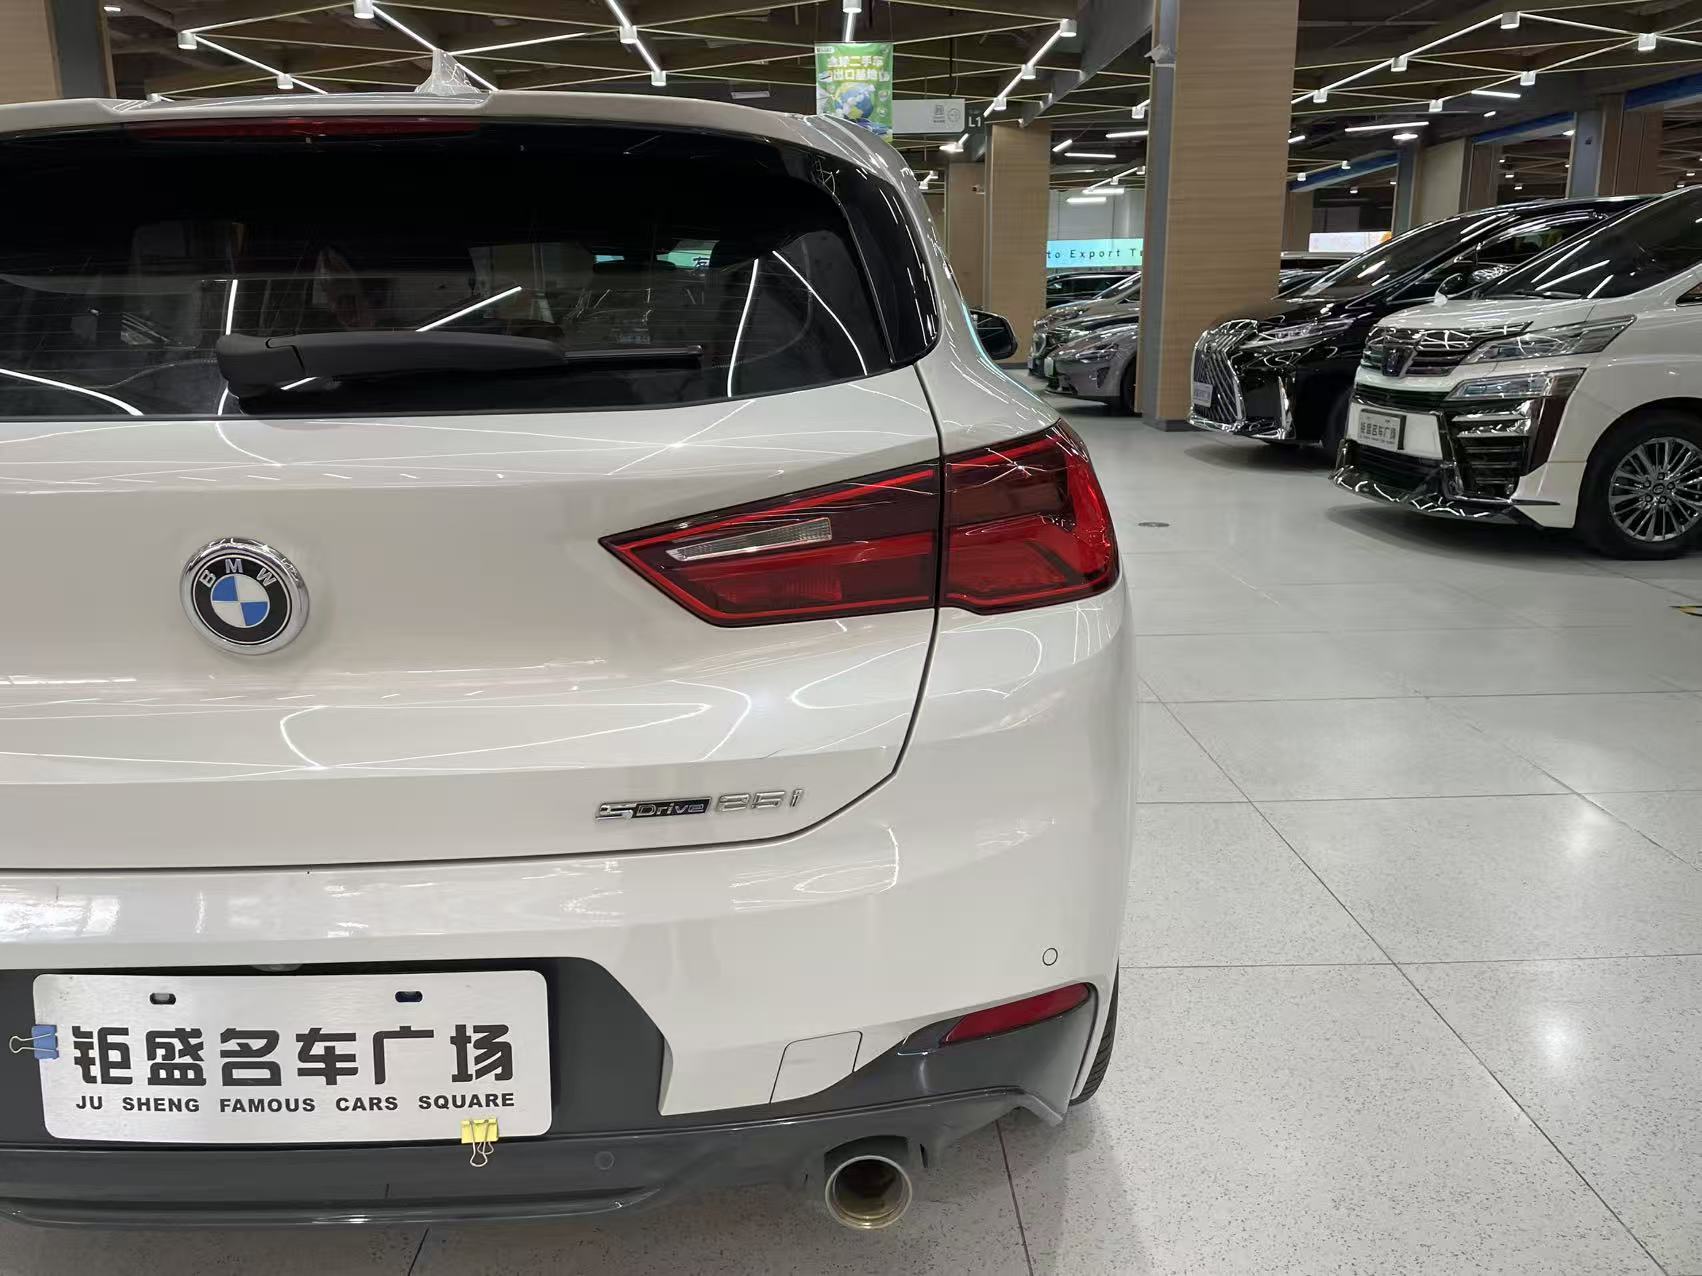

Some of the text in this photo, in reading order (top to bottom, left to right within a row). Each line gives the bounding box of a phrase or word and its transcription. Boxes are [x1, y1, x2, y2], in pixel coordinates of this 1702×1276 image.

[968, 116, 981, 127] L1
[1070, 248, 1121, 260] Export
[199, 558, 277, 588] BMW
[71, 1023, 513, 1087] 钜盛名车广场
[76, 1092, 515, 1113] JU SHENG FAMOUS CARS SQUARE
